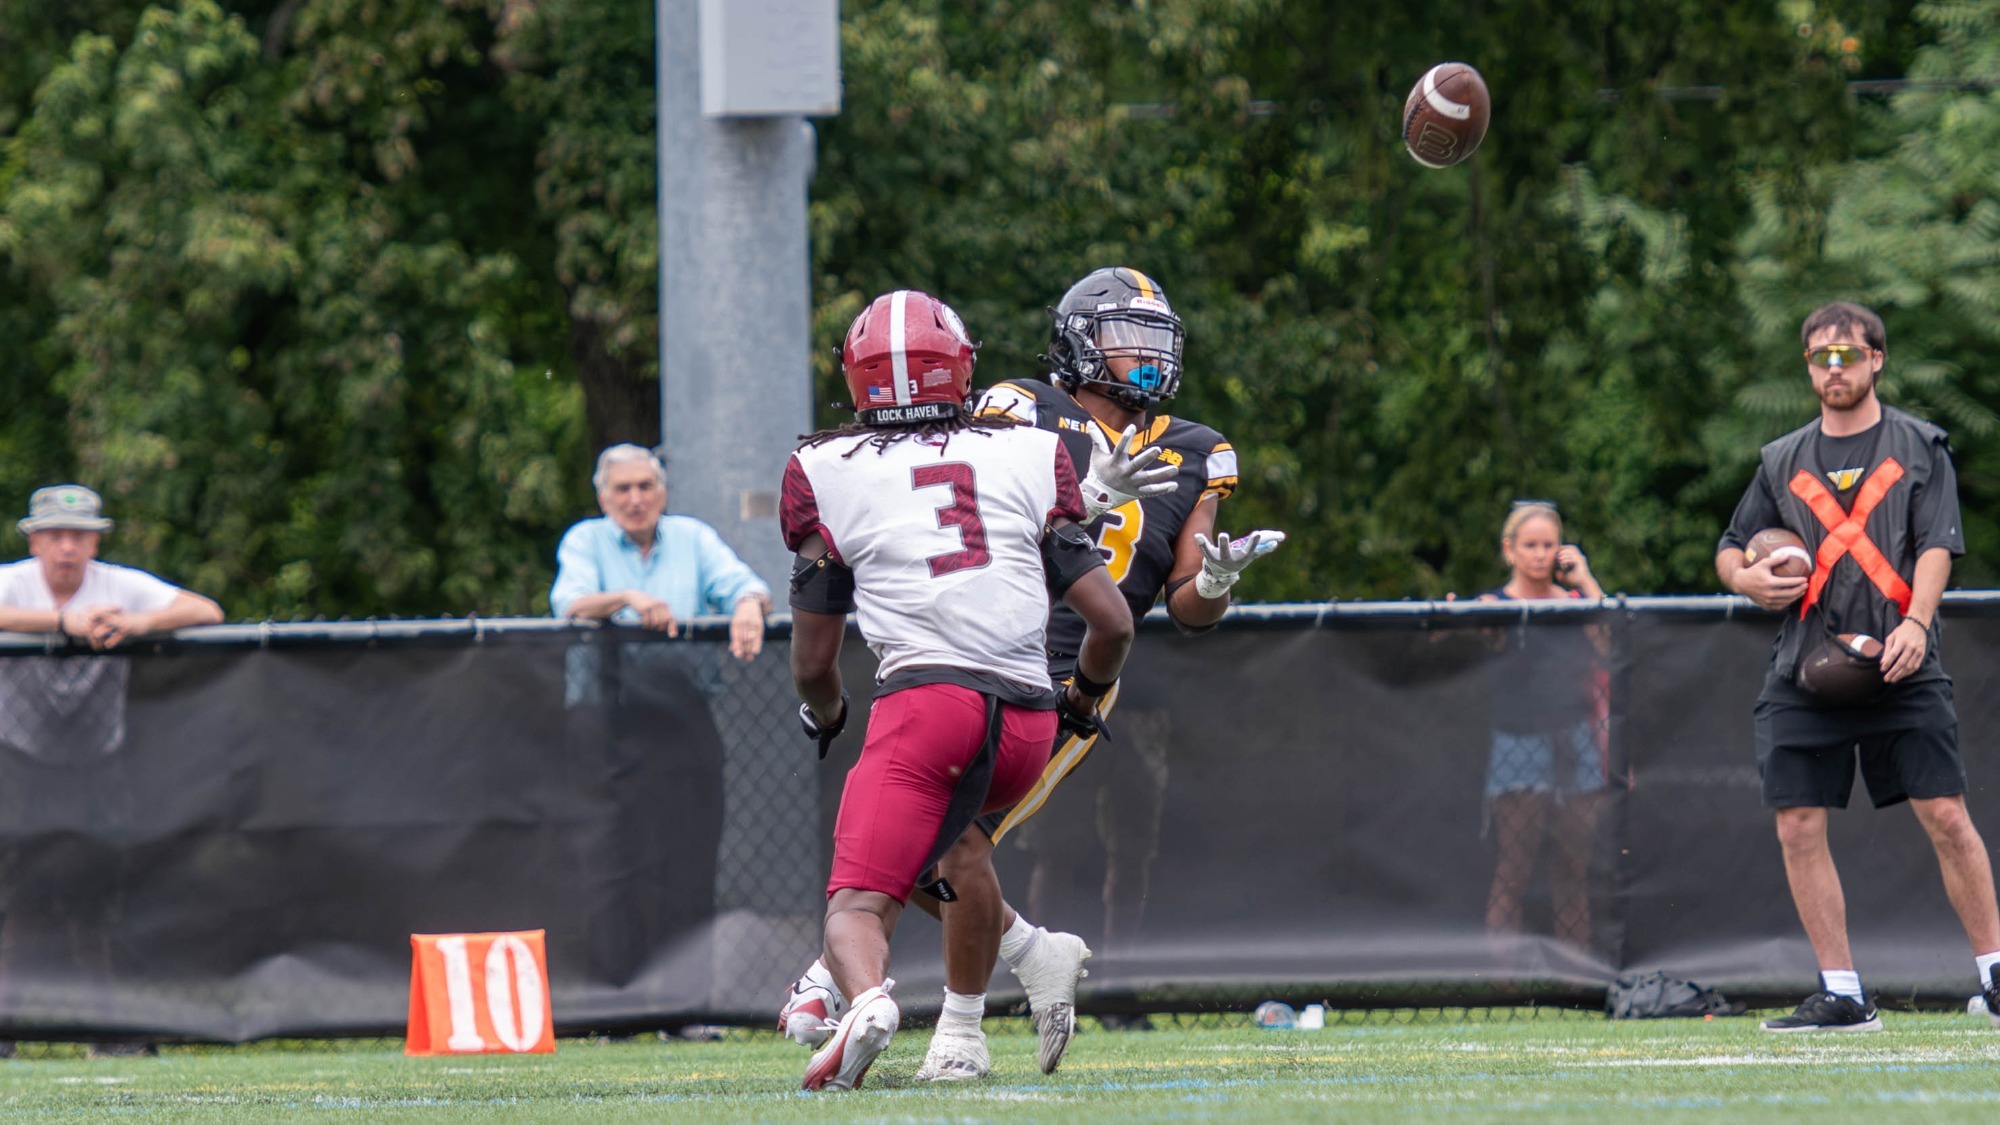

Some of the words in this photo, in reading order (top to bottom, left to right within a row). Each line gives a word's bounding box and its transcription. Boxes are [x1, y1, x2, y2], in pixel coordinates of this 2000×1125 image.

[877, 409, 903, 421] LOCK
[905, 404, 939, 419] HAVEN
[908, 379, 919, 394] 3
[909, 460, 993, 579] 3
[435, 934, 546, 1053] 10
